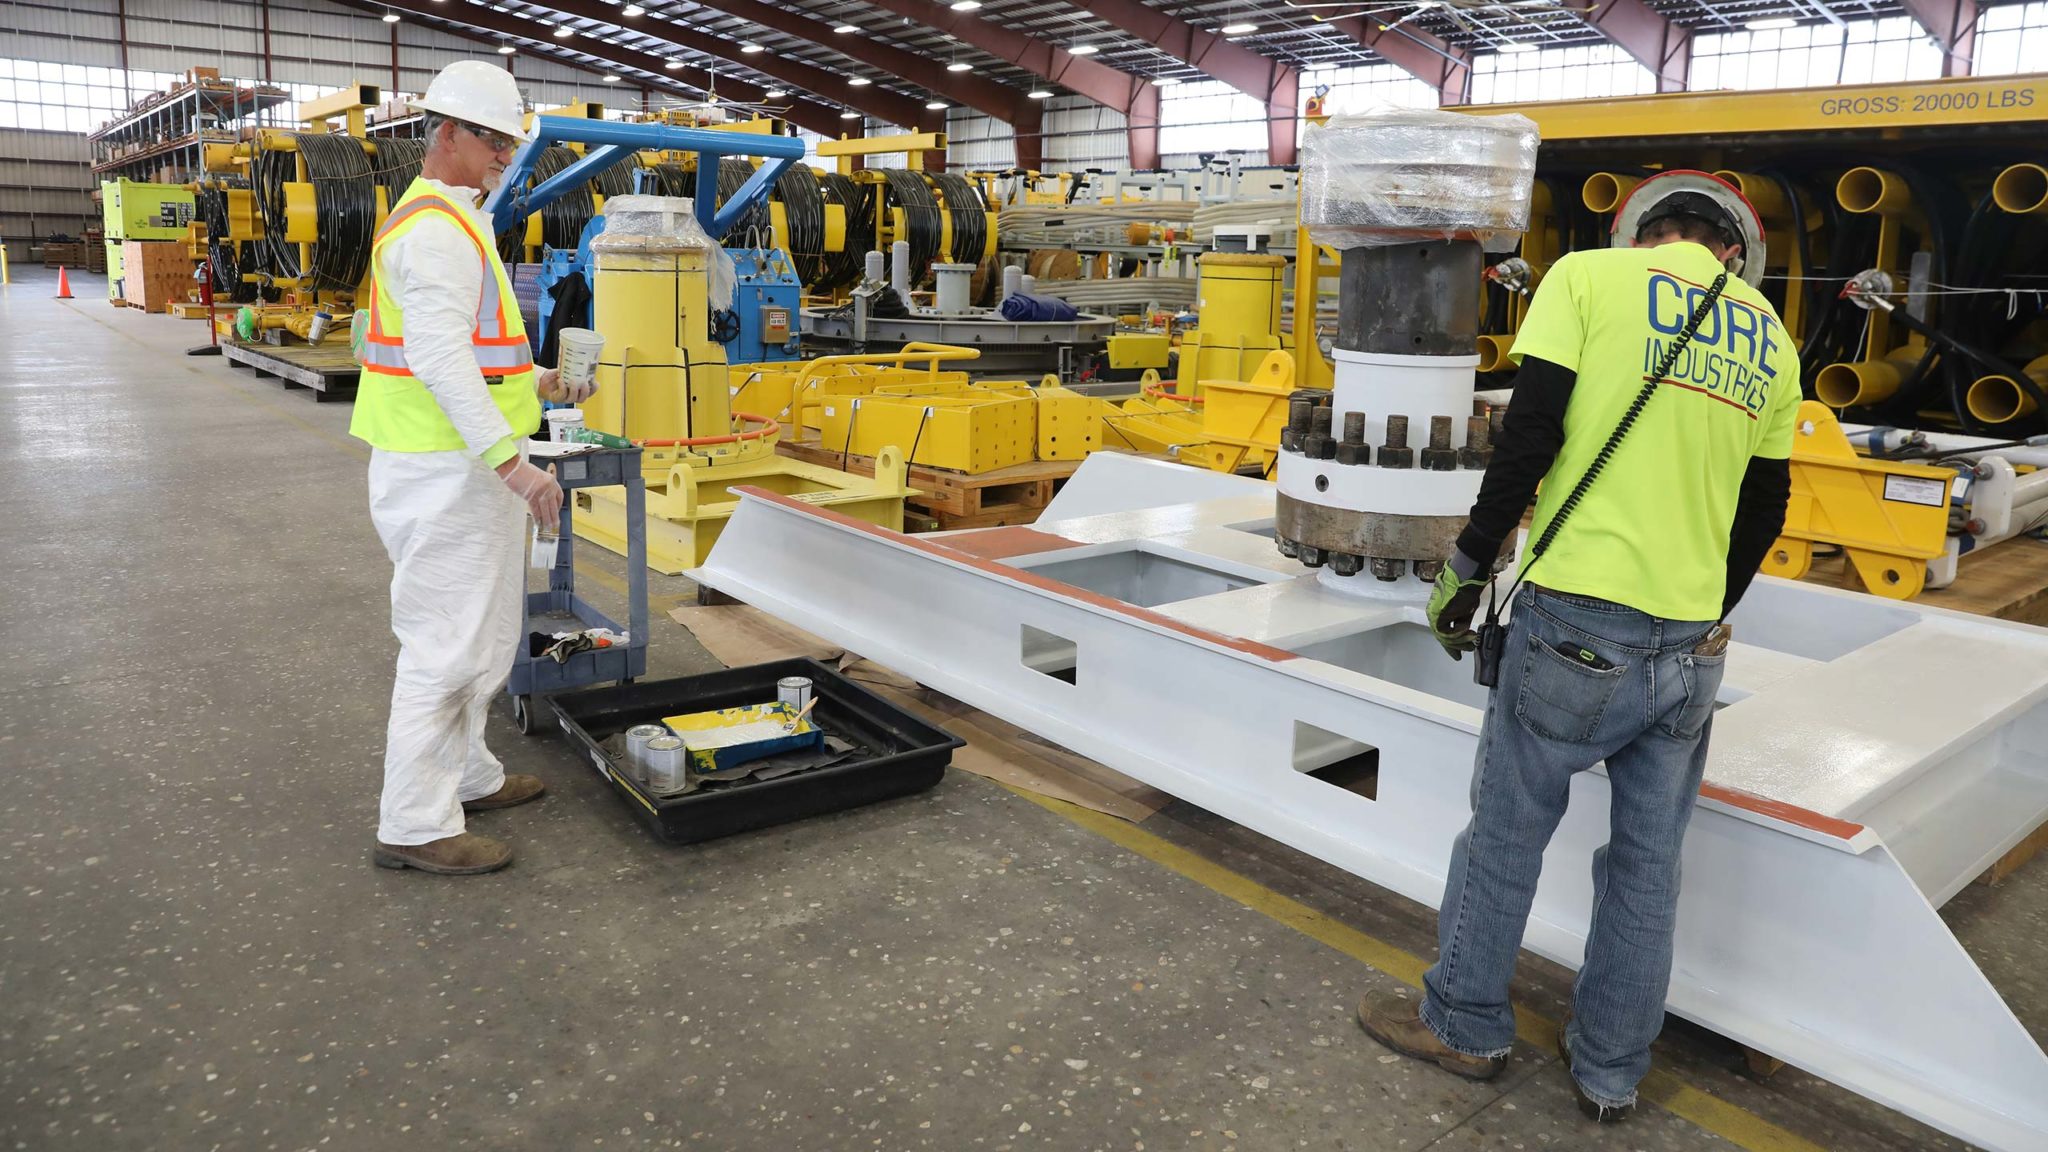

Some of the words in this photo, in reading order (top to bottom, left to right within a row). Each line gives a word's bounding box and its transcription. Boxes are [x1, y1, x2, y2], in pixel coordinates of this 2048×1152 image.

[1821, 96, 1906, 115] GROSS:
[1912, 92, 1980, 112] 20000
[1987, 88, 2035, 108] LBS
[1648, 275, 1779, 379] CORE
